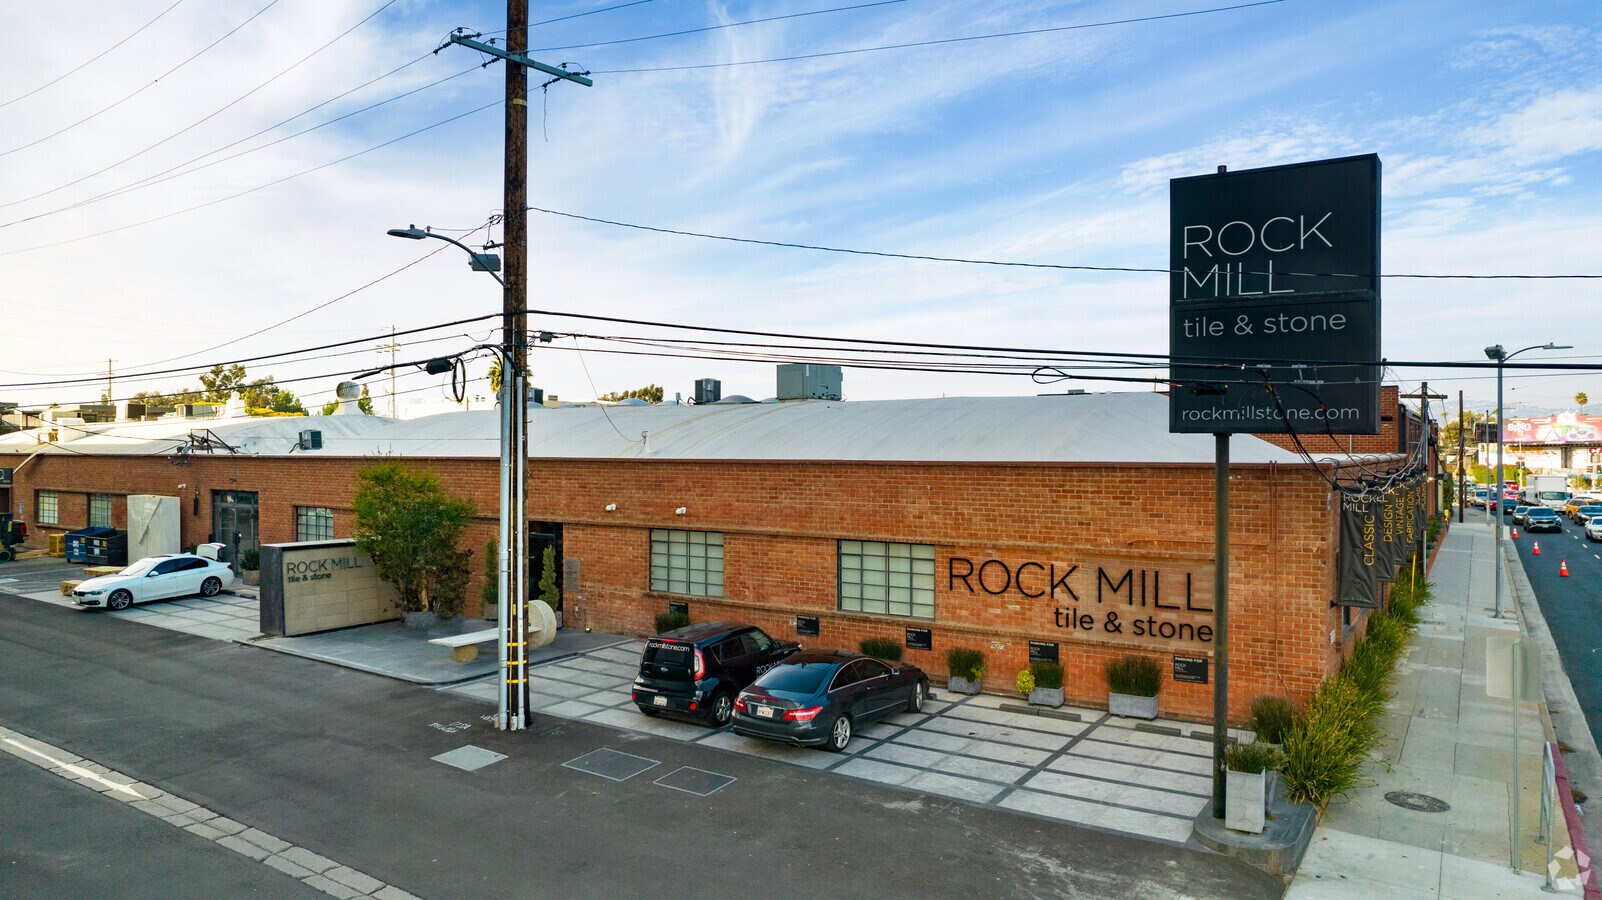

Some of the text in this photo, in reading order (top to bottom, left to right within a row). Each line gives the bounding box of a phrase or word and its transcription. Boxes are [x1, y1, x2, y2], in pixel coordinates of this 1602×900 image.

[1184, 212, 1333, 259] ROCK
[1184, 260, 1295, 299] MILL
[1183, 313, 1346, 337] tile & stone
[1182, 405, 1360, 421] rockmillstone.com
[1343, 502, 1369, 513] MILL
[1383, 504, 1393, 543] DESIGN
[1396, 496, 1405, 535] VINTAGE
[1406, 490, 1415, 544] FABRICATION
[1364, 515, 1375, 566] CLASSIC
[287, 556, 362, 575] ROCK MILL
[288, 575, 301, 583] tile
[310, 573, 332, 581] stone
[949, 557, 1214, 613] ROCK MILL
[1054, 607, 1214, 642] tile & stone
